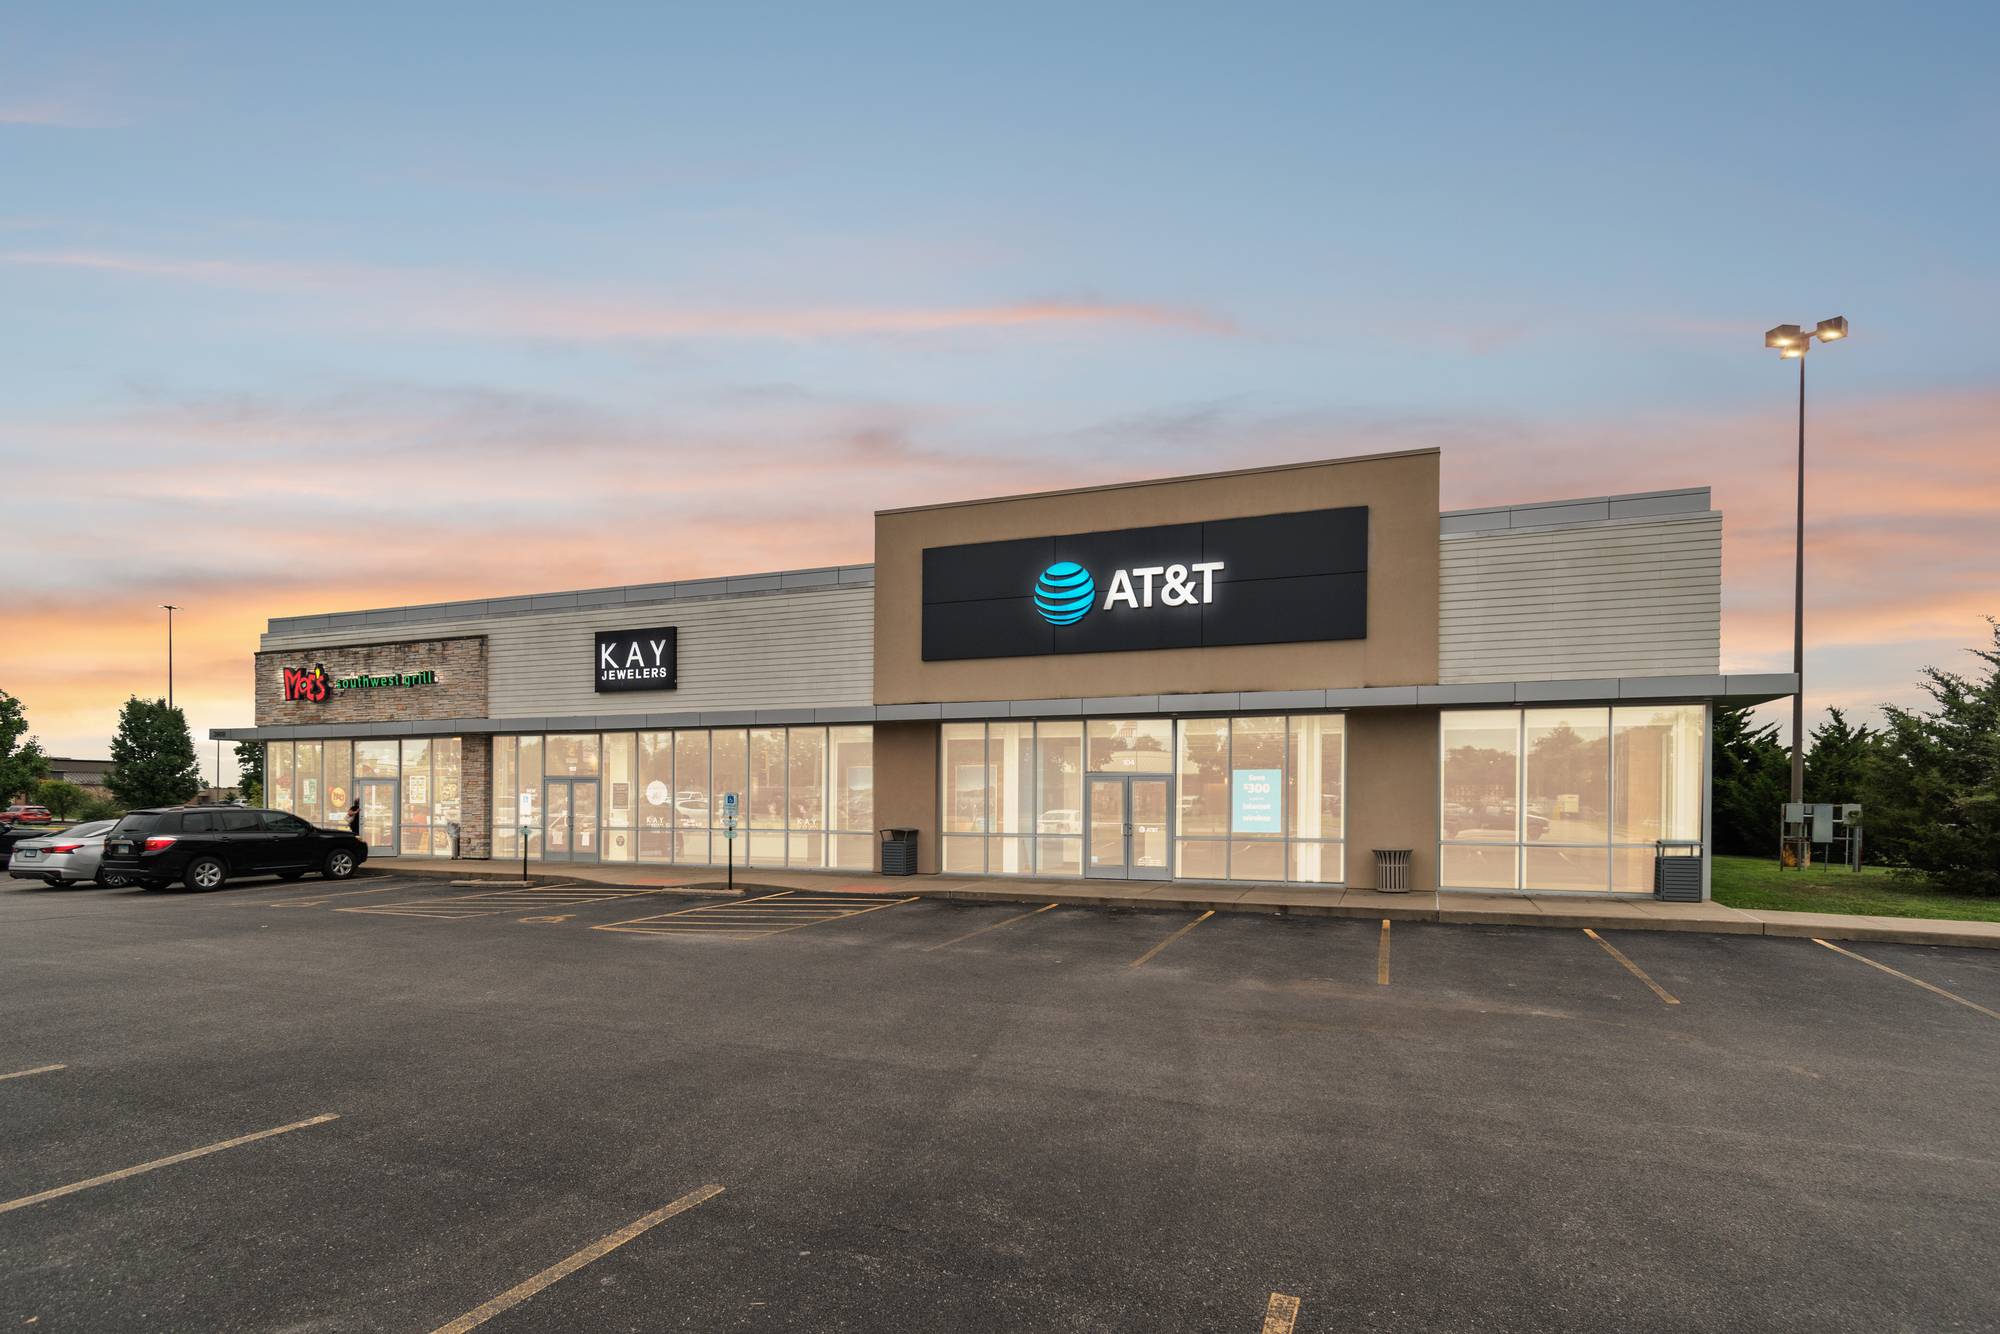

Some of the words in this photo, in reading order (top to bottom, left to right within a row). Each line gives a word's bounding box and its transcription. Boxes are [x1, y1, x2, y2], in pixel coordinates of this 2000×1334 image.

[1103, 561, 1225, 610] AT&T
[601, 639, 667, 669] KAY
[336, 673, 399, 689] southwest
[403, 671, 432, 688] grill
[601, 667, 667, 681] JEWELERS
